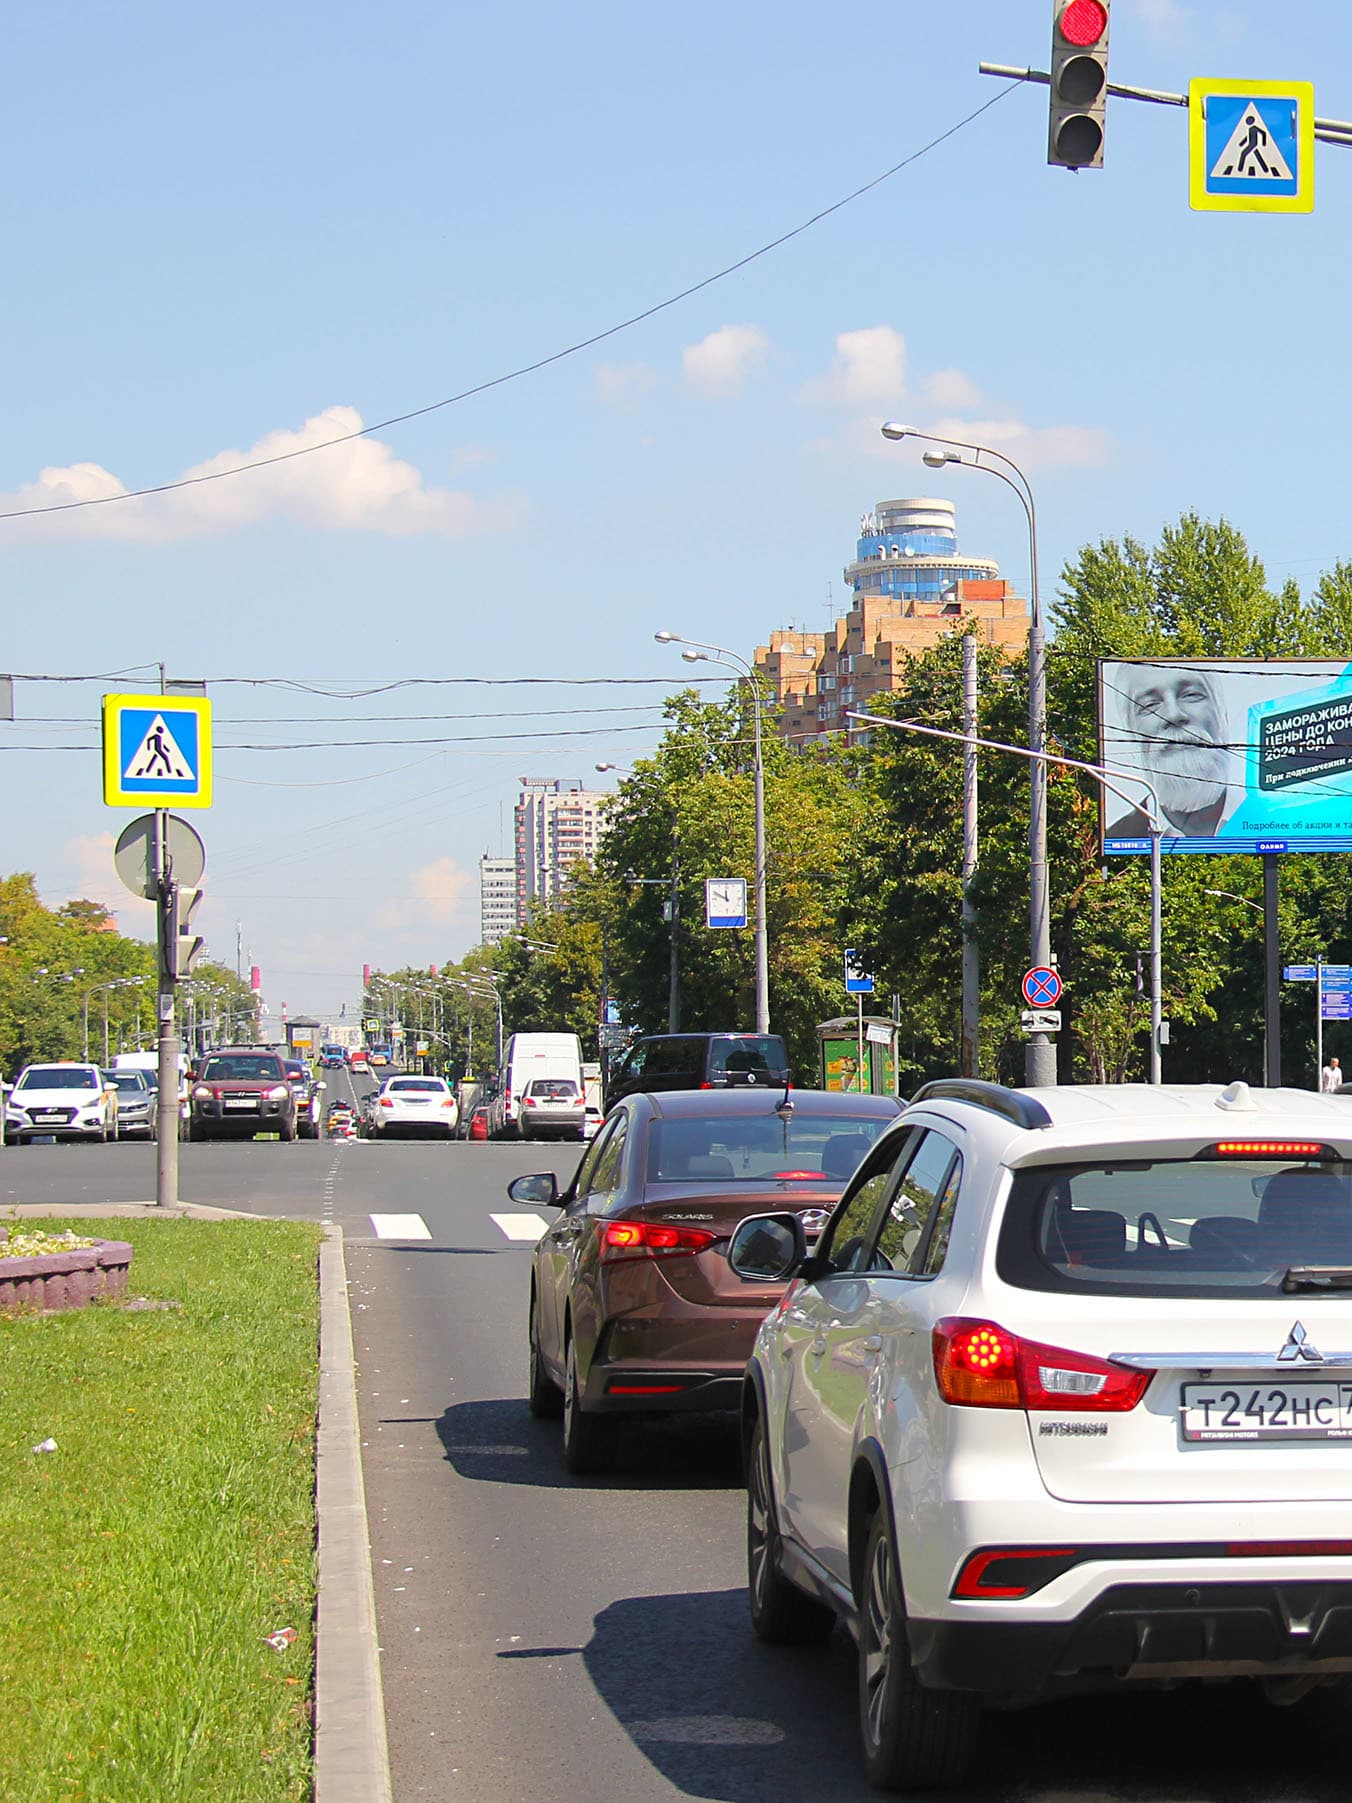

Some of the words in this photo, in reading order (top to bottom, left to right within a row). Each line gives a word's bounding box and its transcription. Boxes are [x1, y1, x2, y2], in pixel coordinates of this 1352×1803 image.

[1264, 745, 1297, 762] 2024
[1299, 734, 1335, 754] ГОДА
[1265, 729, 1303, 749] ЦЕНЫ
[1305, 723, 1325, 740] ДО
[1265, 773, 1284, 785] При
[1242, 821, 1290, 832] Подробнее
[1292, 820, 1303, 830] об
[1196, 1389, 1334, 1427] Т242НС
